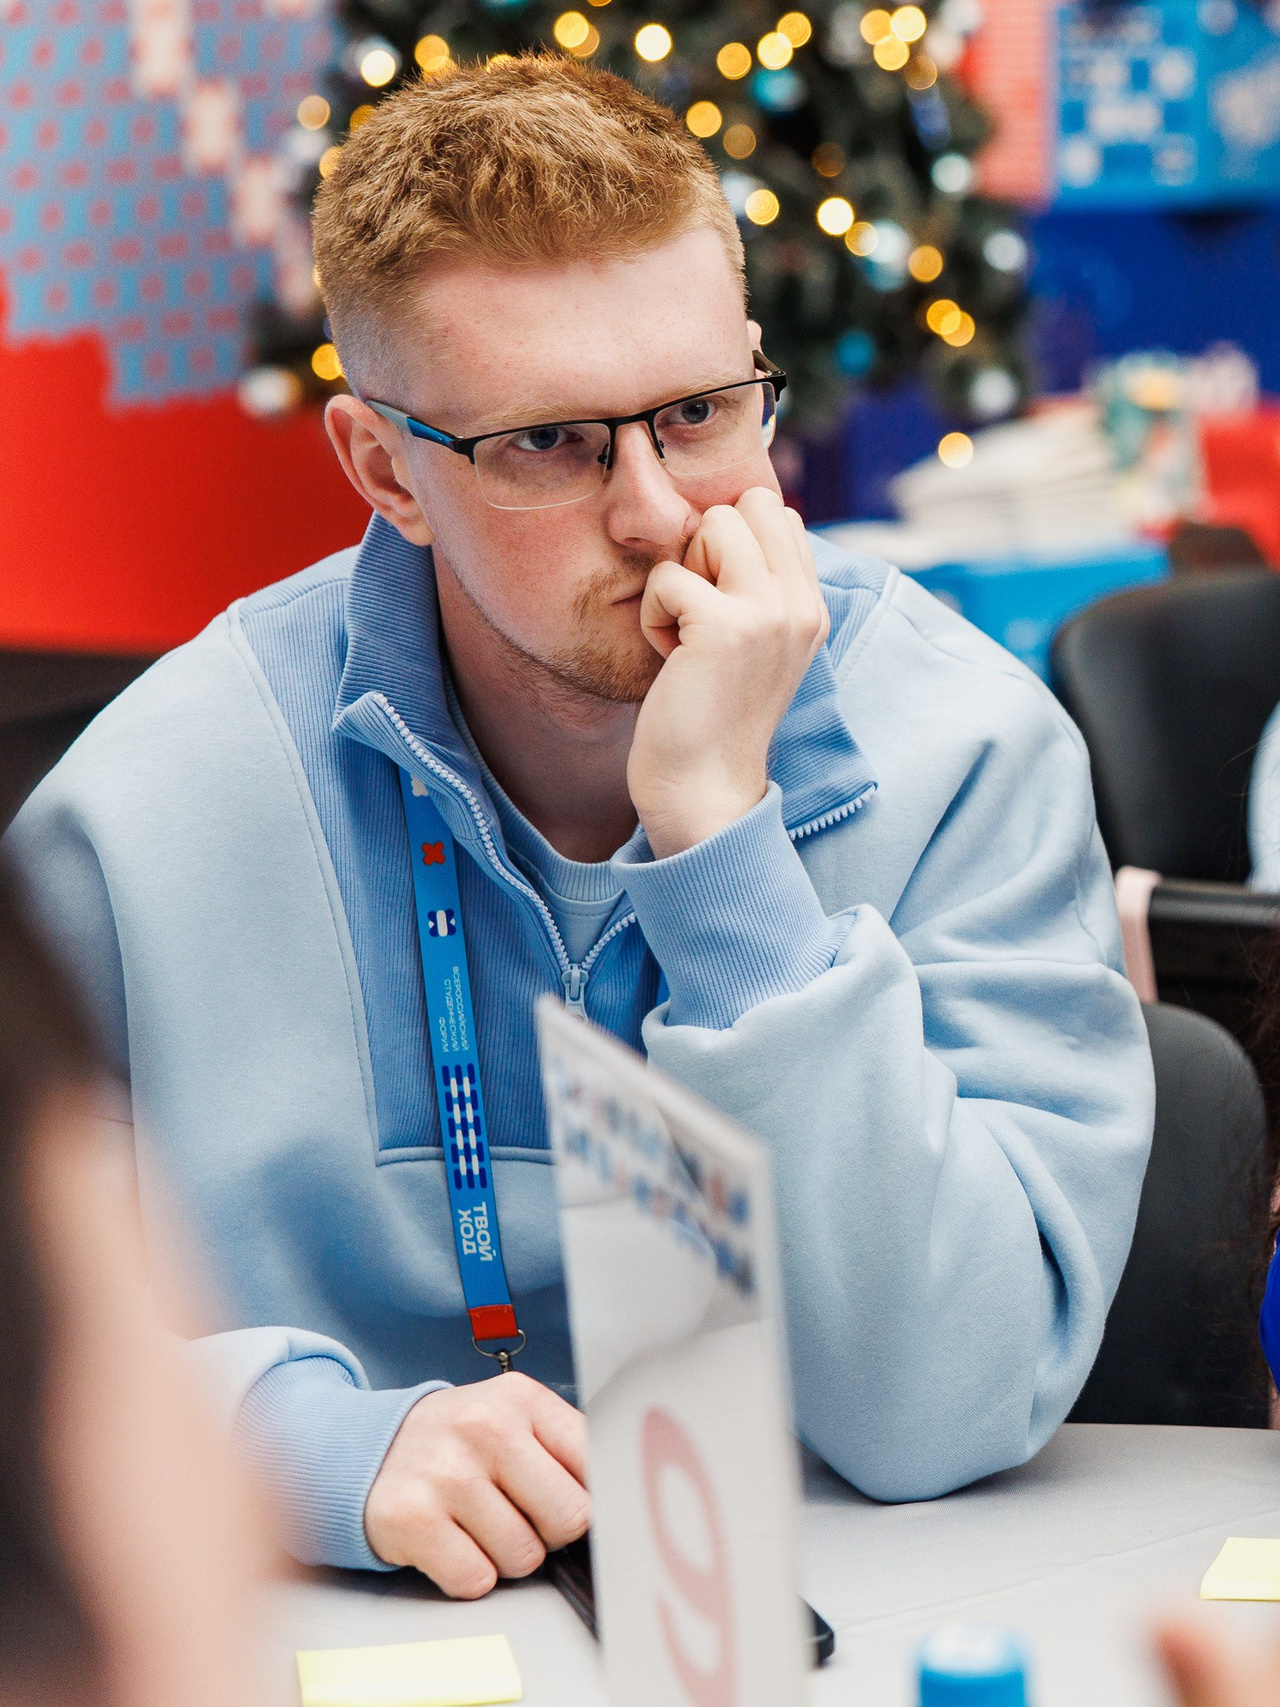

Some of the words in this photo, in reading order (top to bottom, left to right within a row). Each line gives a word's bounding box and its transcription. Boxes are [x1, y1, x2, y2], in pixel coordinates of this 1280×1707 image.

[439, 1016, 449, 1052] ФОРУМ
[444, 978, 459, 1051] СТУДЕНЧЕСКИЙ
[453, 966, 469, 1051] ВСЕРОССИЙСКИЙ
[457, 1208, 477, 1255] ХОД
[473, 1201, 496, 1261] ТВОЙ
[640, 1403, 736, 1707] 9
